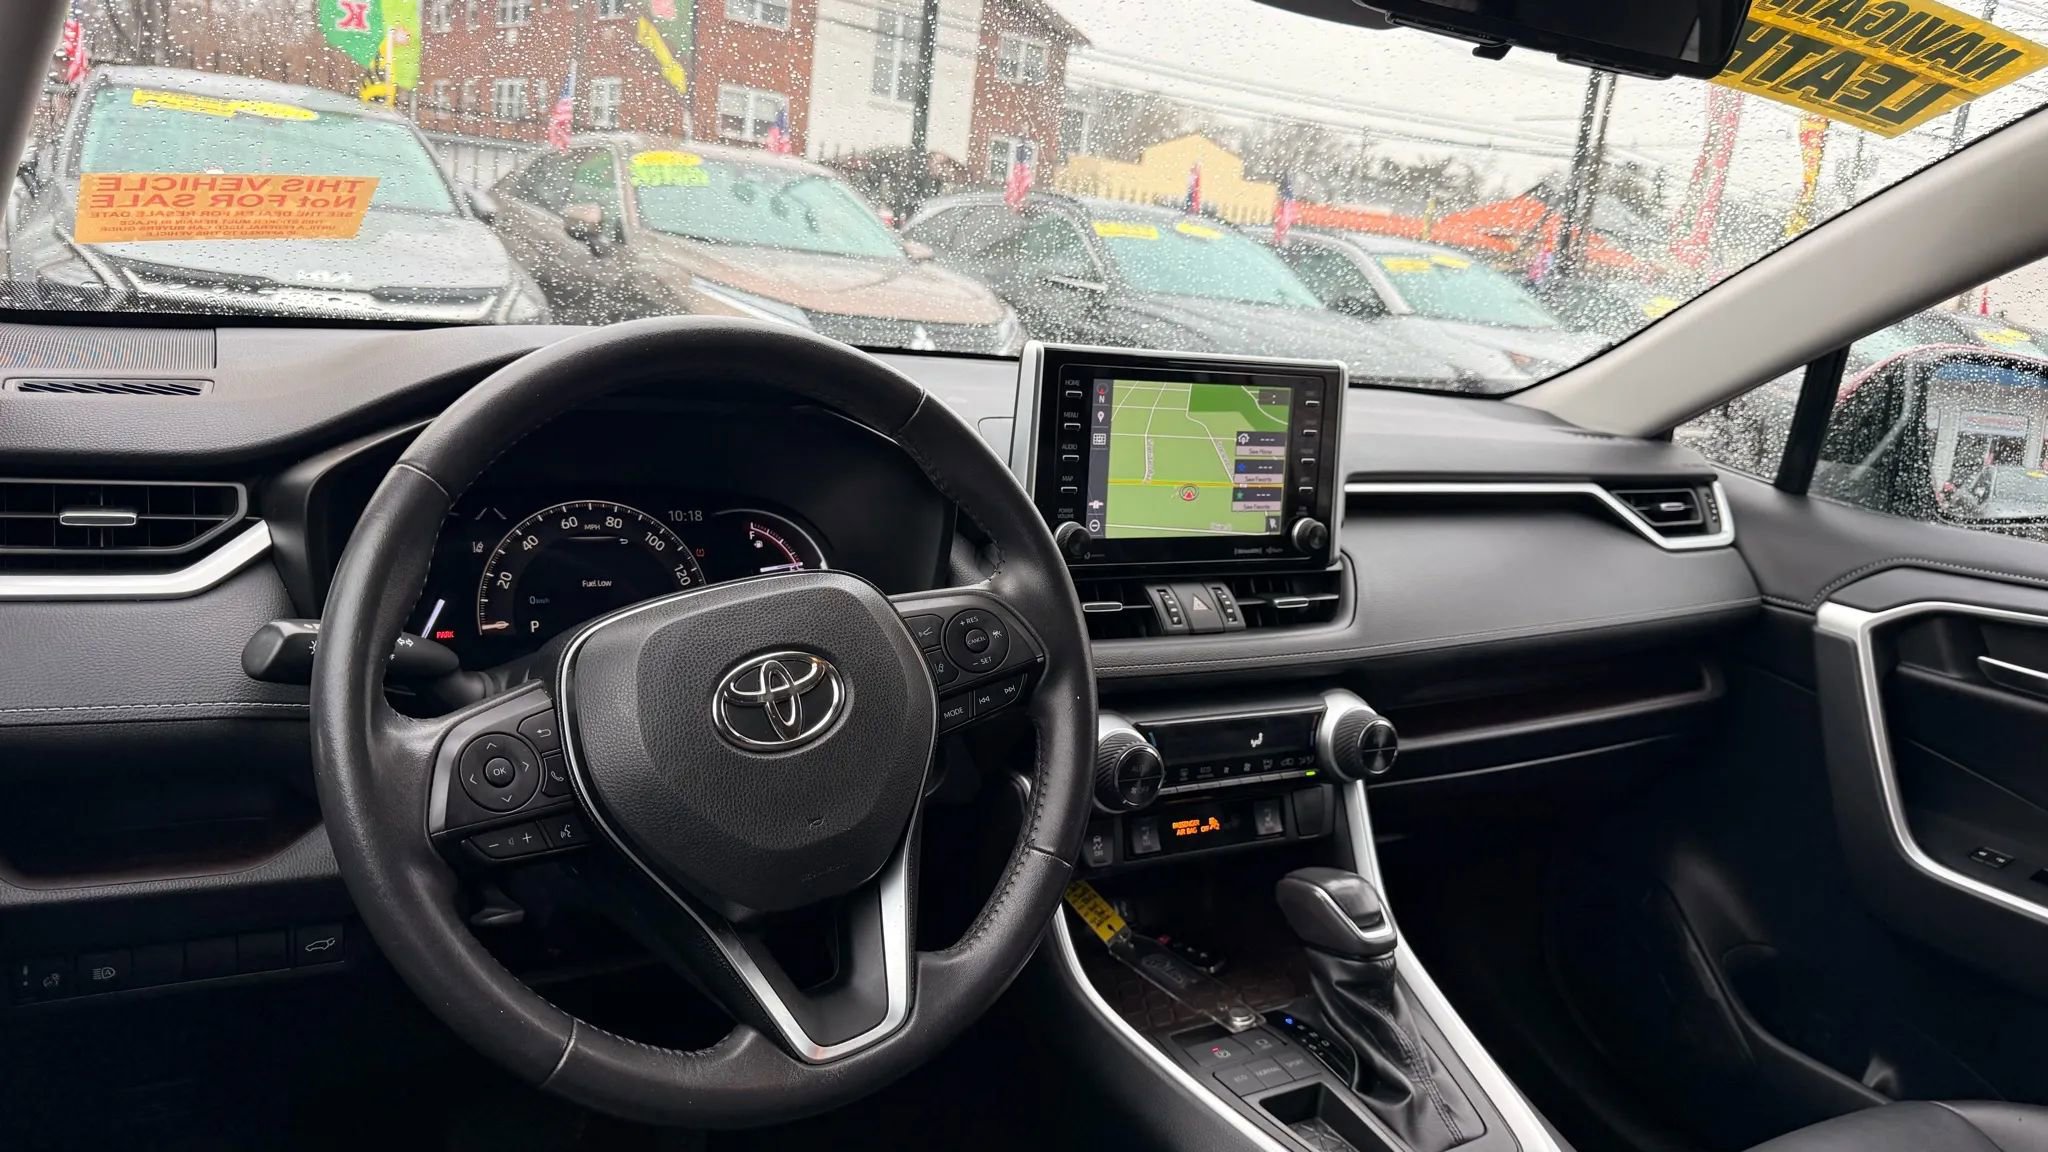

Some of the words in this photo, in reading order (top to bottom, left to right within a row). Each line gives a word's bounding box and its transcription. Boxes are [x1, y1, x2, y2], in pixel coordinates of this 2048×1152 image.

[1098, 395, 1106, 404] N
[667, 510, 703, 522] 10:18
[560, 516, 579, 530] 60
[584, 523, 601, 531] MPH
[605, 516, 623, 530] 80
[643, 531, 666, 552] 100
[749, 530, 756, 541] F
[521, 534, 540, 552] 40
[496, 571, 513, 590] 20
[673, 563, 692, 587] 120
[581, 579, 597, 588] Fuel
[597, 579, 613, 588] Low
[529, 620, 541, 633] P
[436, 630, 456, 640] PARK
[966, 635, 986, 646] CANCEL
[980, 656, 993, 666] SET
[943, 706, 965, 719] MODE
[493, 767, 507, 776] OK
